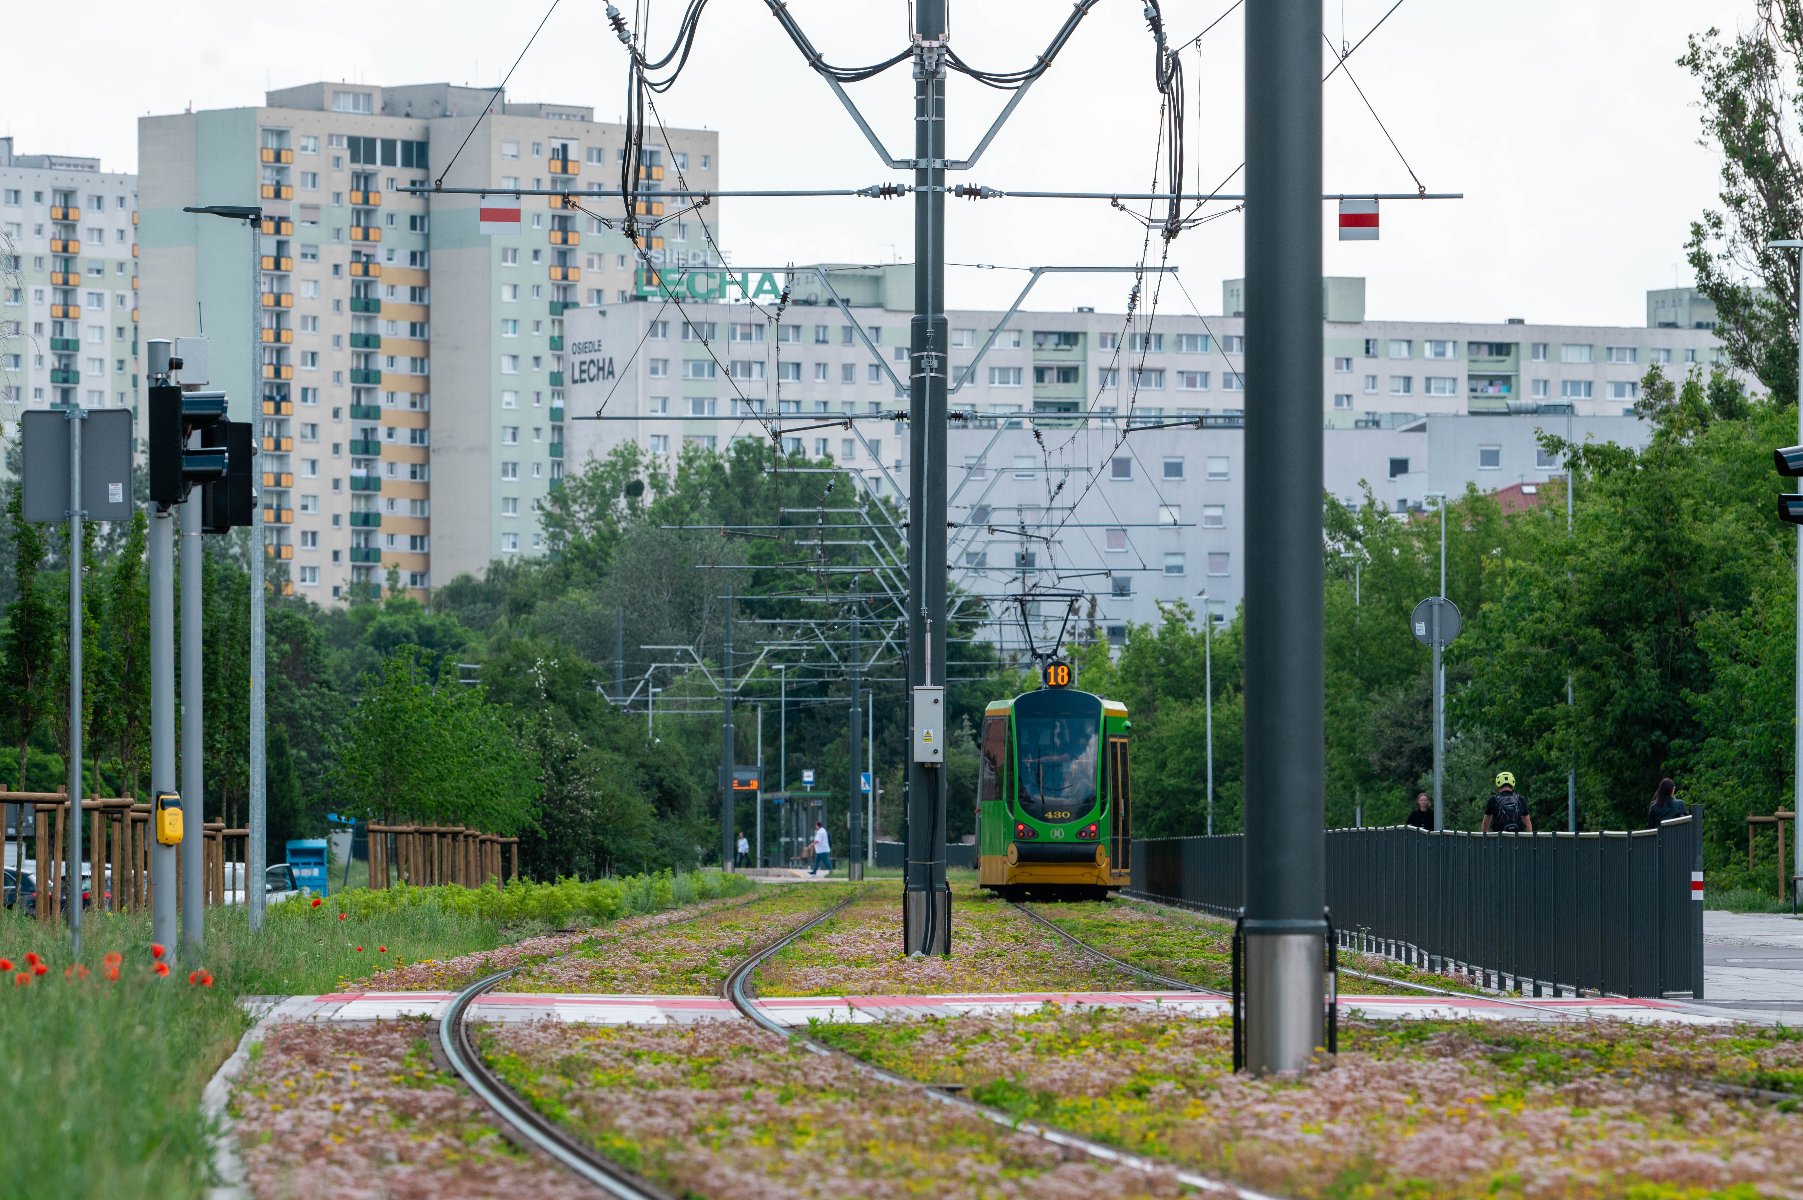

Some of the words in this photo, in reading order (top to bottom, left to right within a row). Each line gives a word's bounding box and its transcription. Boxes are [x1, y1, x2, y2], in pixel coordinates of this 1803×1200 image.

[634, 248, 732, 266] OSIEDLE
[636, 268, 783, 299] LECHA
[572, 339, 602, 355] OSIEDLE
[571, 357, 615, 384] LECHA
[1047, 665, 1069, 685] 18
[1044, 811, 1071, 819] 430
